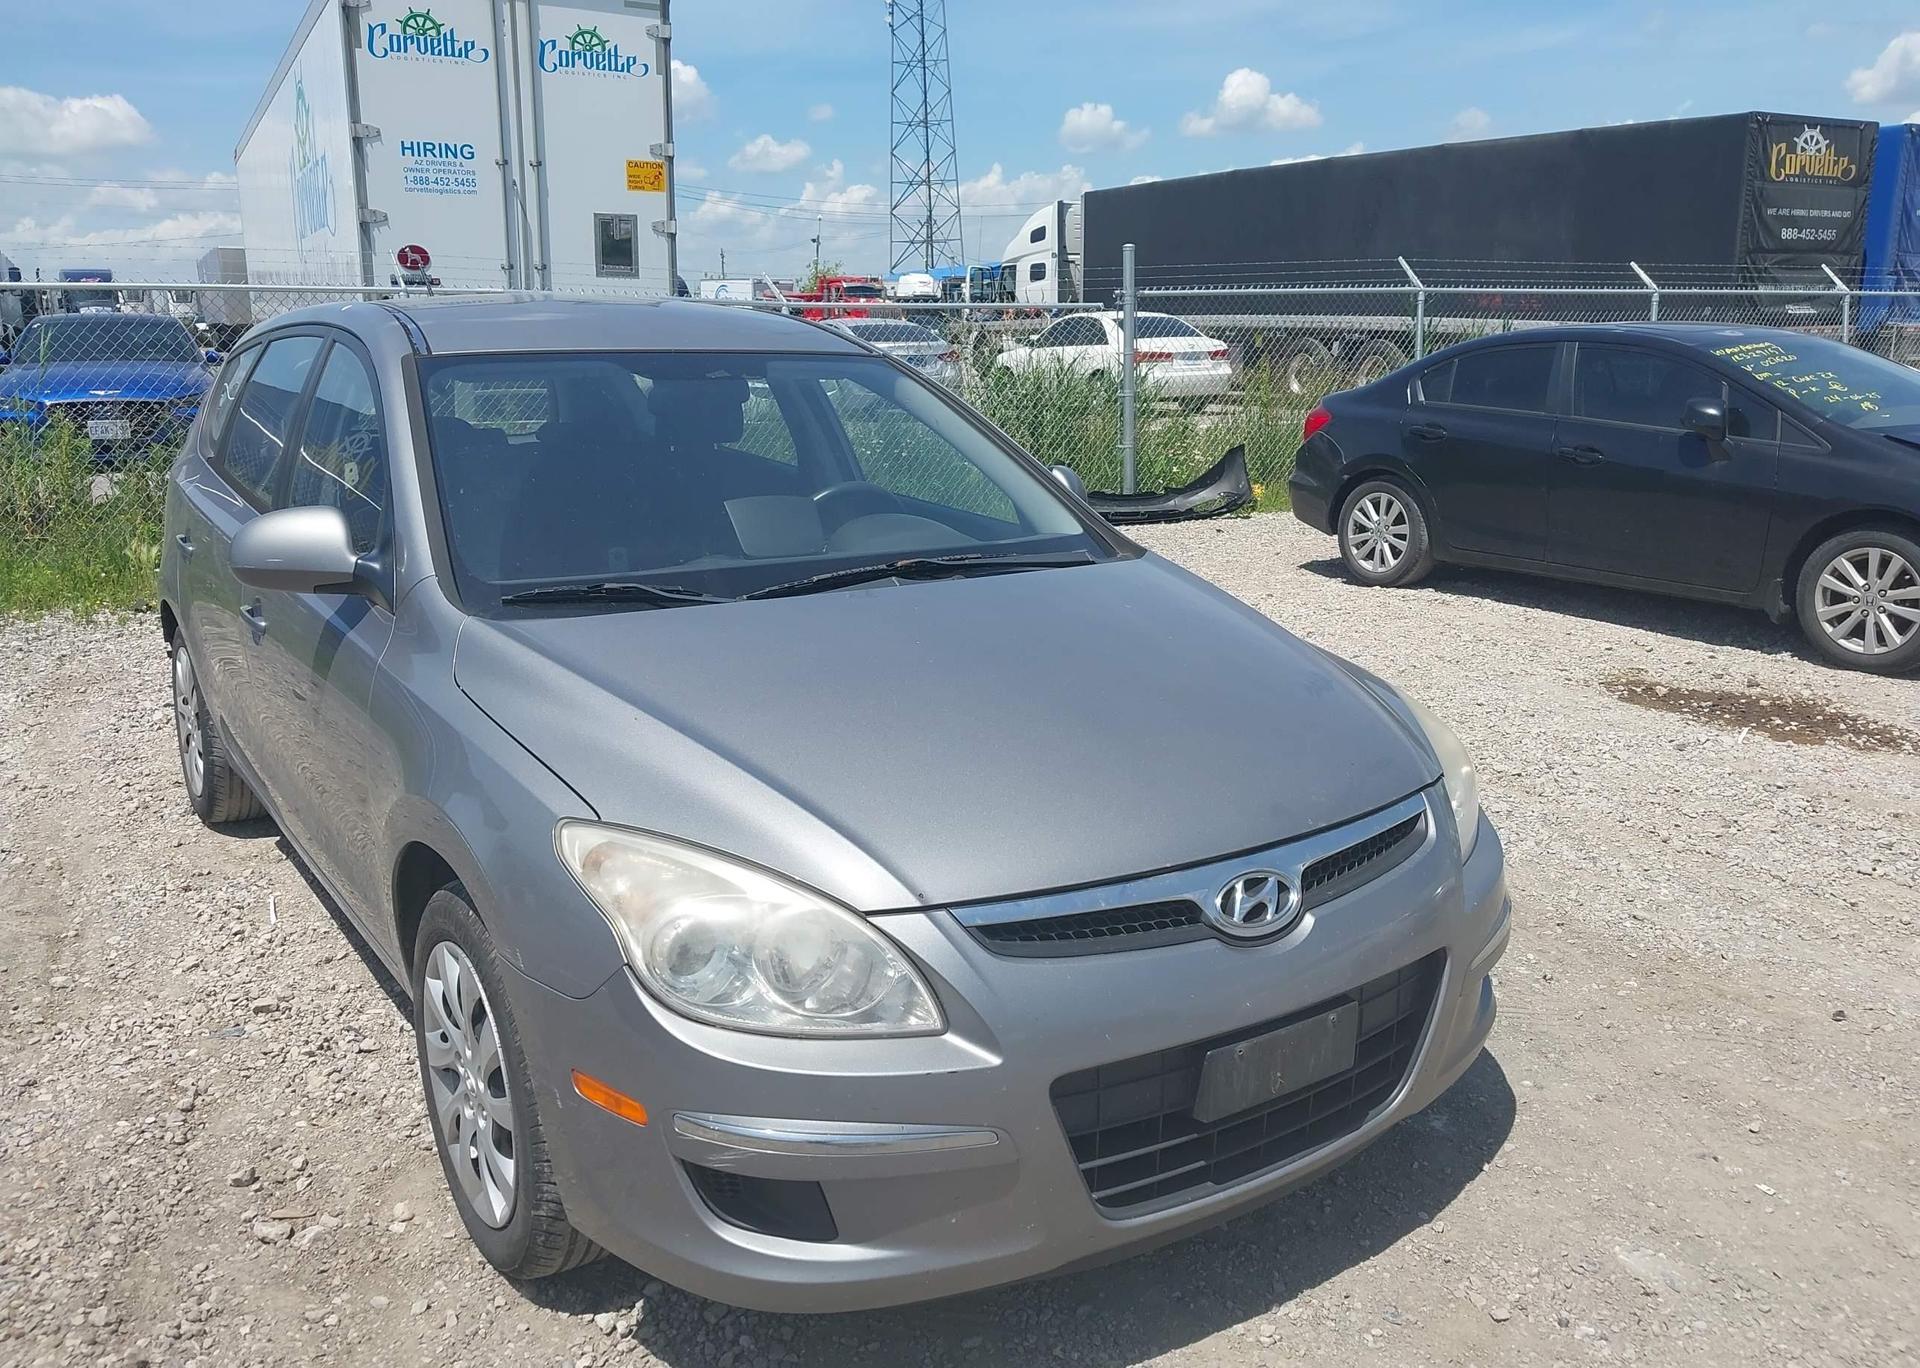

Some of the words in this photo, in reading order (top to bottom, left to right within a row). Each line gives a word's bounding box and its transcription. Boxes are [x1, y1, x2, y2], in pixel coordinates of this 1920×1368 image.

[367, 22, 490, 63] Corvette
[390, 55, 443, 64] LOGISTICS
[538, 38, 649, 78] Corvette
[559, 70, 607, 78] LOGISTICS
[401, 140, 475, 160] HIRING
[425, 160, 457, 168] DRIVERS
[1770, 142, 1856, 181] Corvette
[403, 166, 431, 174] OWNER
[432, 168, 476, 176] OPERATORS
[404, 175, 477, 188] 1-888-452-5455
[404, 187, 478, 195] corvettelogistics.com
[1778, 208, 1790, 216] ARE
[1791, 208, 1809, 217] HIRING
[1809, 209, 1831, 217] DRIVERS
[1781, 227, 1837, 240] 888-452-5455
